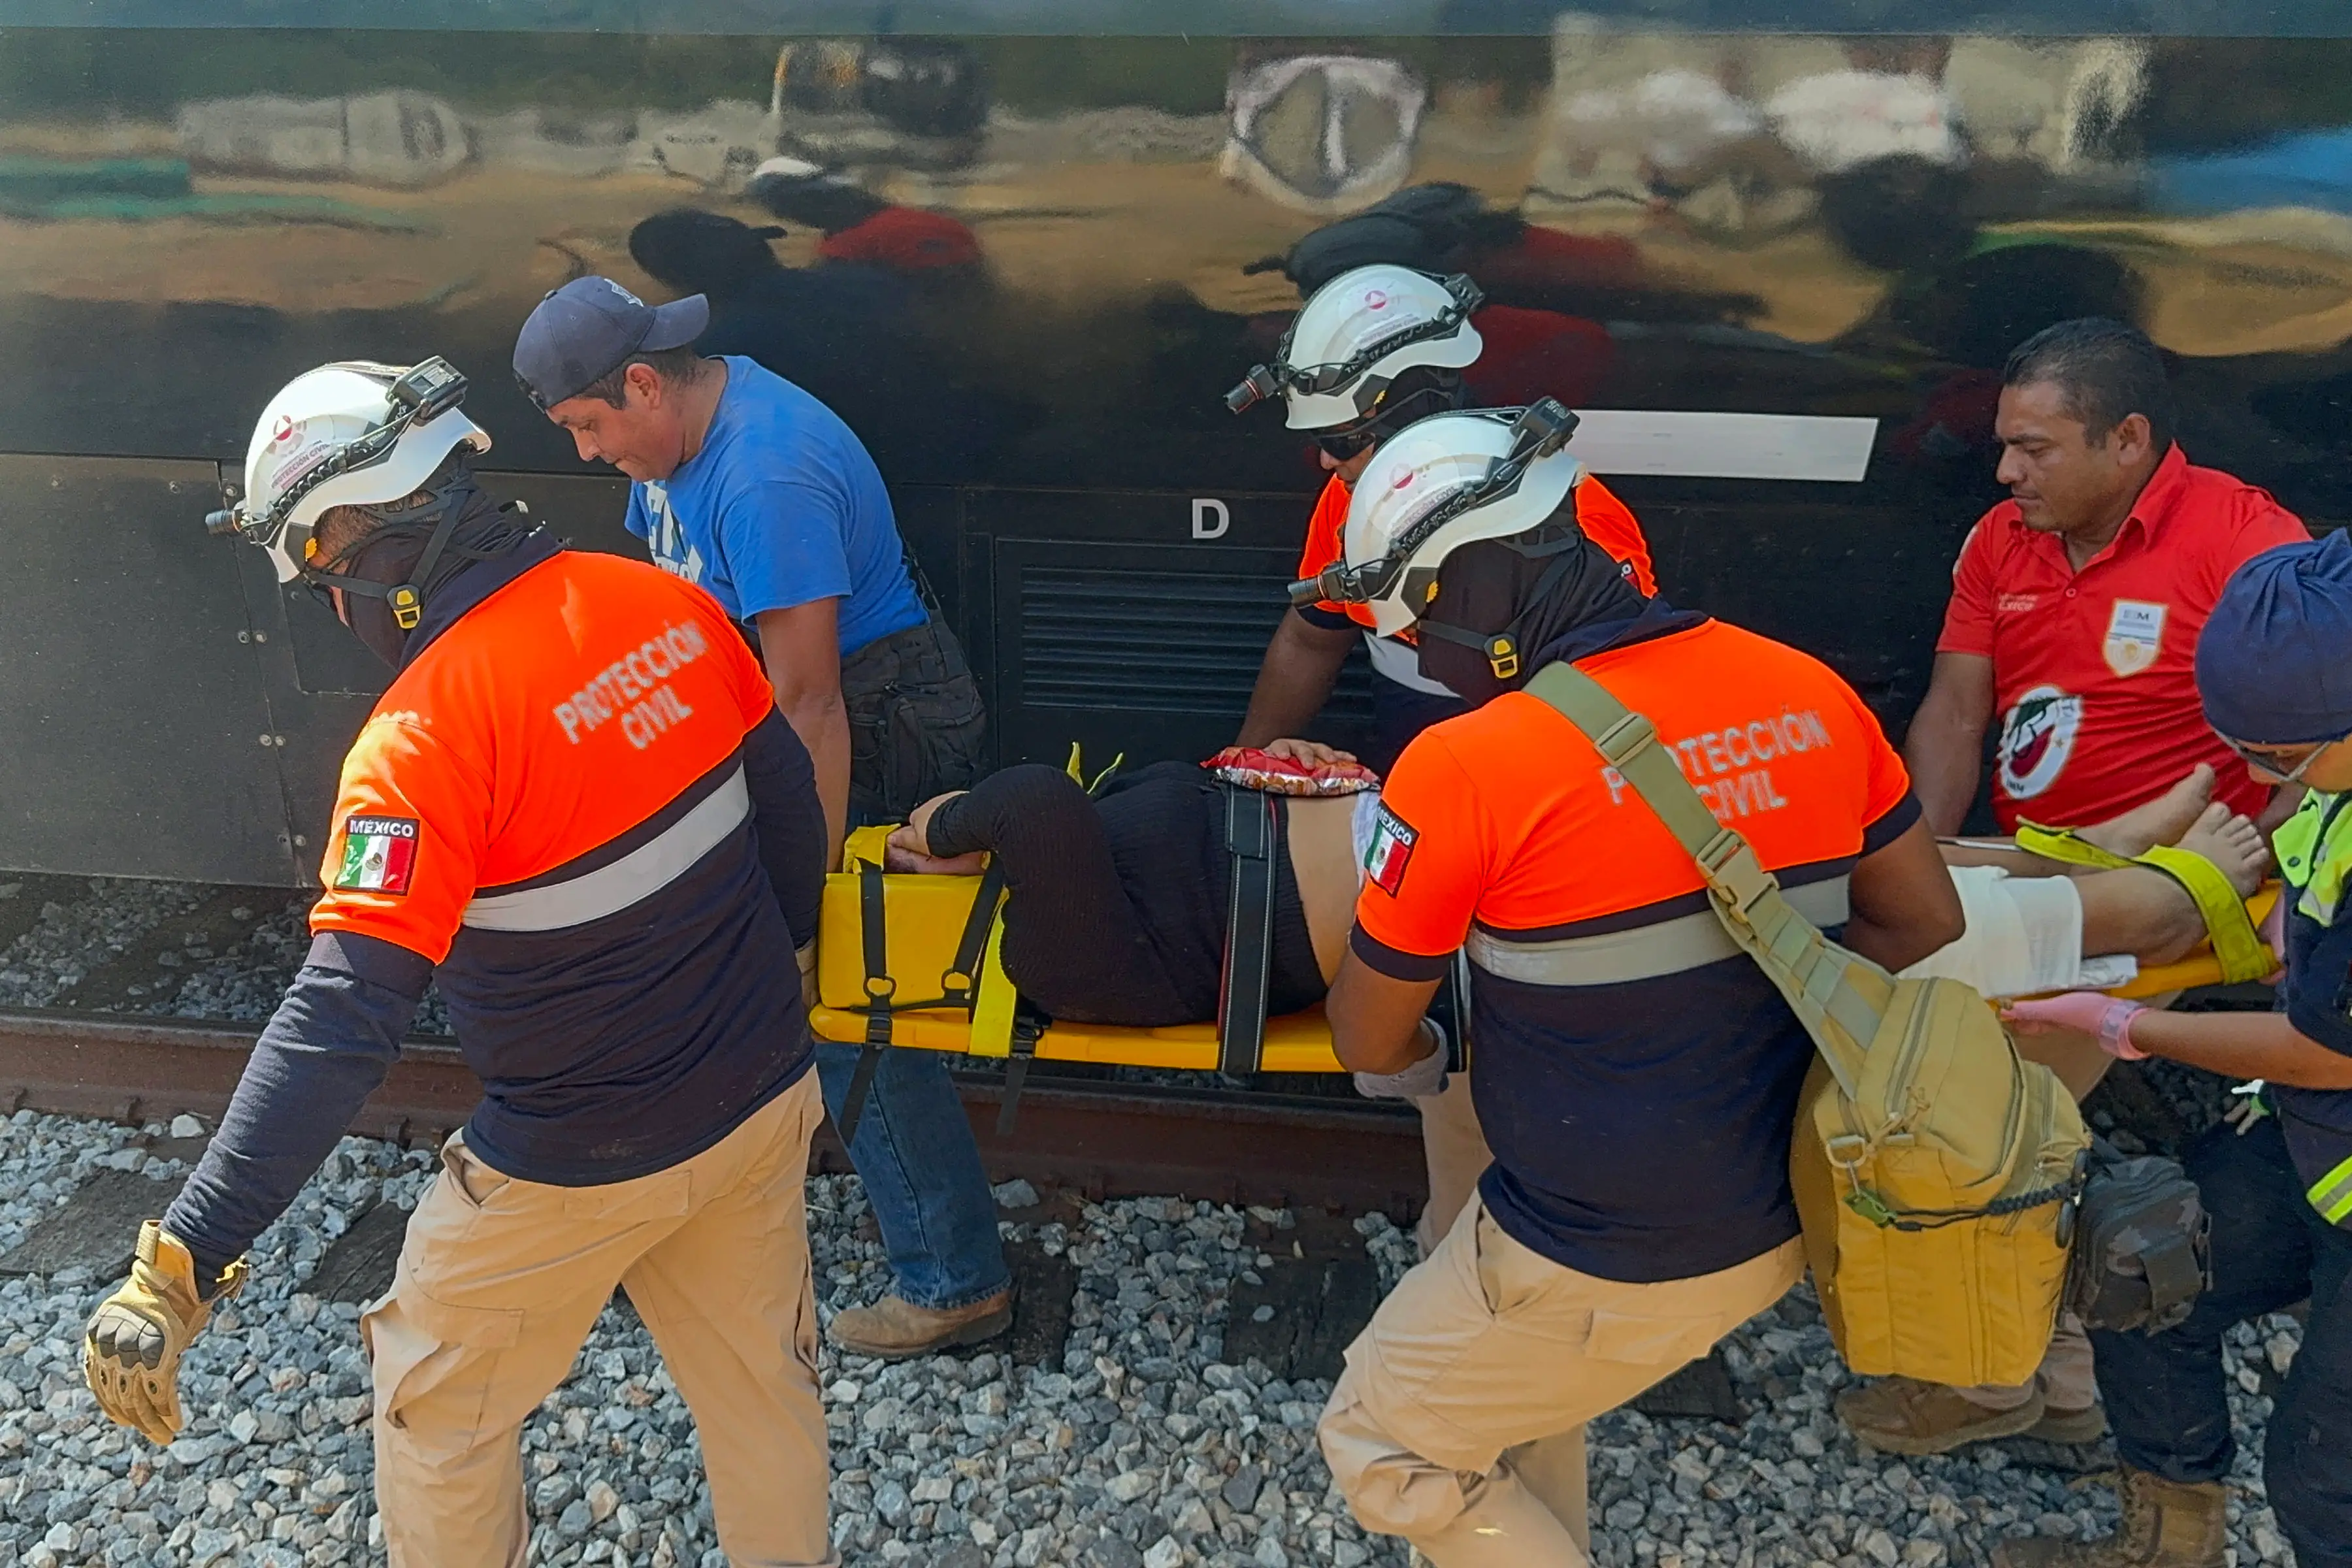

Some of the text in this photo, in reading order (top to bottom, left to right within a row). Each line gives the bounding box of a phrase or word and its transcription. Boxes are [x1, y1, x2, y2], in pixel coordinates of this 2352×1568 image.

[1192, 498, 1229, 539] D
[553, 619, 708, 745] PROTECCIÓN
[621, 683, 693, 750] CIVIL
